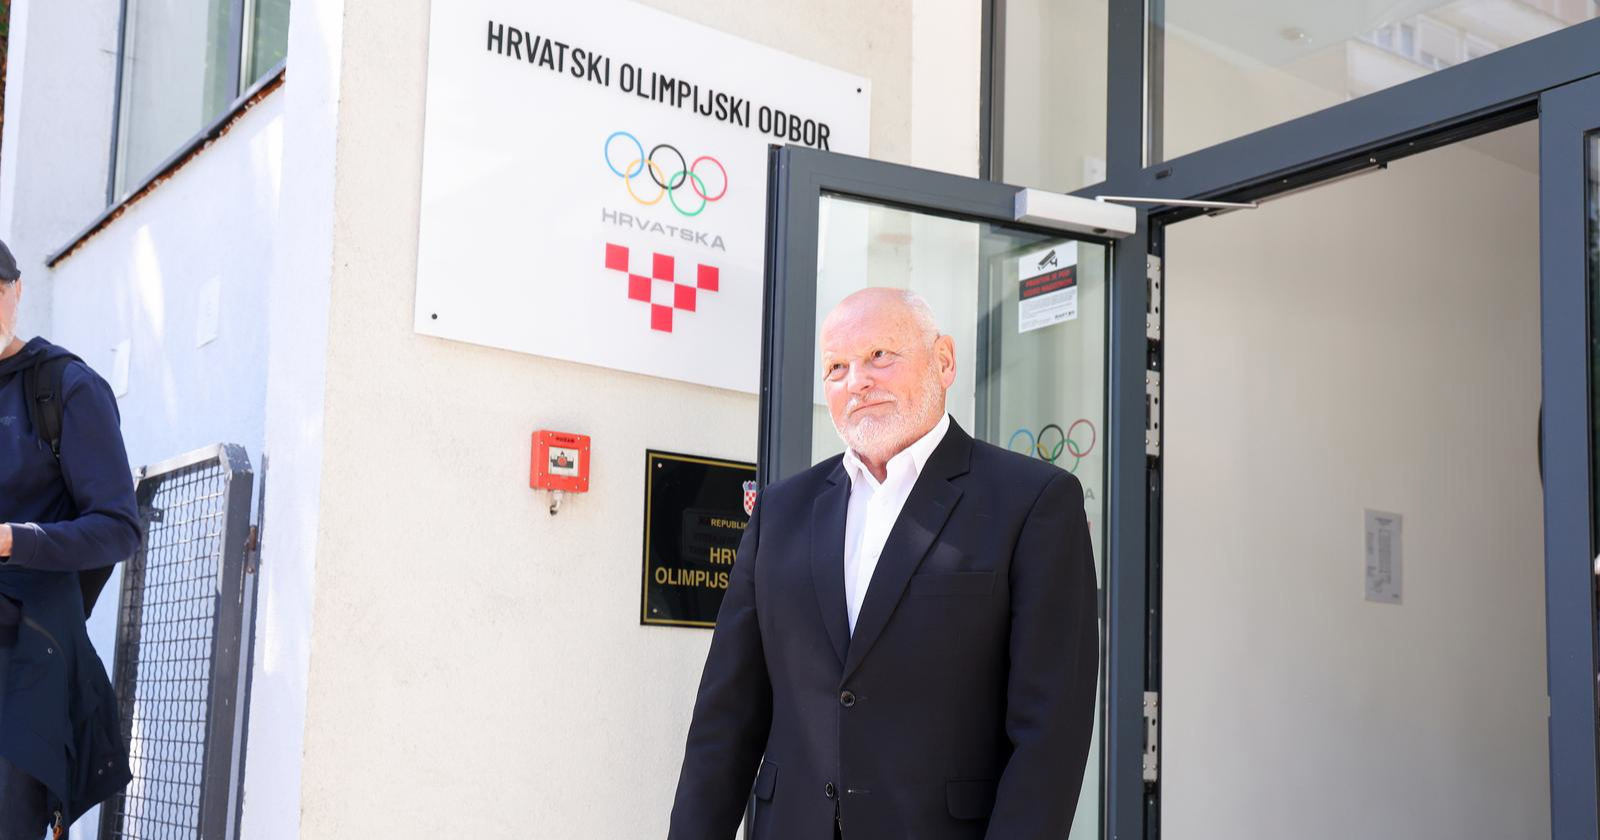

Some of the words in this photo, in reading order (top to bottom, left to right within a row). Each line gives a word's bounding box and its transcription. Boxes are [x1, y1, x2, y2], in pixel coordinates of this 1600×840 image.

[487, 20, 611, 87] HRVATSKI
[619, 63, 751, 128] OLIMPIJSKI
[758, 105, 831, 151] ODBOR
[602, 207, 726, 252] HRVATSKA
